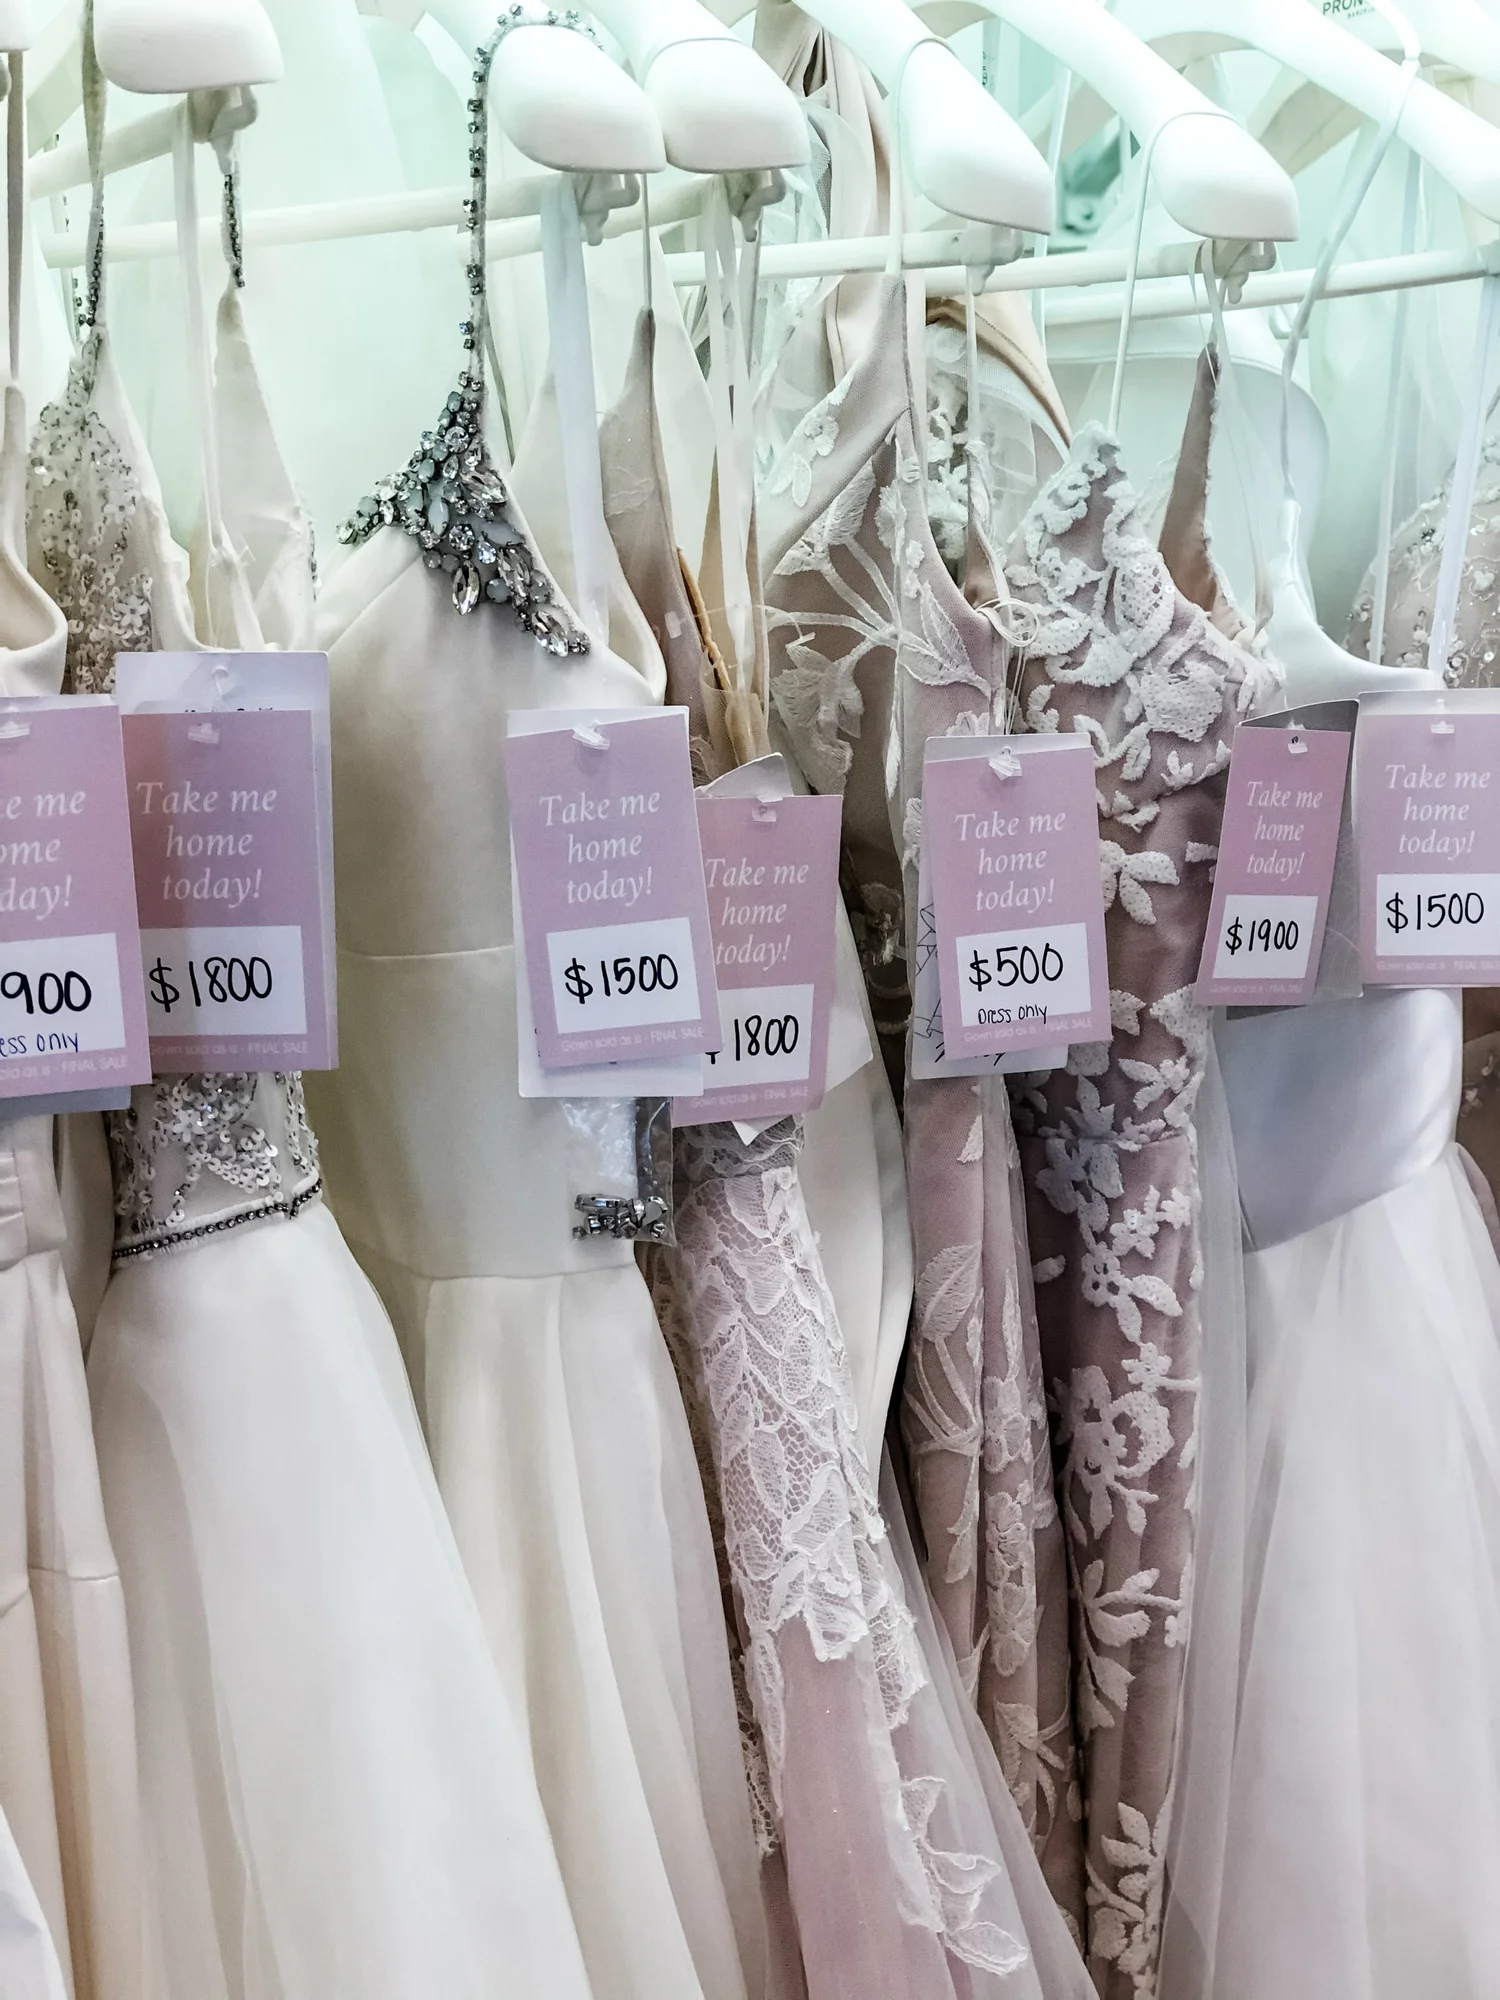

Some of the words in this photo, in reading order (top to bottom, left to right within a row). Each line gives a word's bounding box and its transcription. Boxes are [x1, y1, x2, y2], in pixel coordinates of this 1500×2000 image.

[1323, 0, 1368, 15] PRON
[1385, 764, 1446, 789] Take
[1455, 772, 1491, 788] me
[35, 791, 86, 817] me
[137, 780, 219, 815] Take
[231, 789, 278, 812] me
[538, 792, 610, 826] Take
[621, 792, 660, 816] me
[1247, 781, 1291, 807] Take
[1296, 790, 1323, 809] me
[1404, 796, 1470, 821] home
[166, 825, 253, 857] home
[955, 811, 1020, 841] Take
[1029, 812, 1066, 834] me
[1254, 815, 1304, 841] home
[568, 834, 643, 864] home
[1399, 828, 1475, 860] today!
[706, 857, 766, 888] Take
[773, 864, 809, 885] me
[978, 849, 1047, 875] home
[1247, 849, 1305, 882] today!
[163, 867, 262, 909] today!
[567, 865, 652, 907] today!
[976, 878, 1055, 913] today!
[722, 897, 787, 926] home
[1386, 892, 1484, 933] $1500
[1225, 916, 1299, 955] $1900
[716, 934, 791, 971] today!
[969, 942, 1063, 992] $500
[0, 971, 92, 1015] 900
[149, 957, 272, 1013] $1800
[564, 954, 679, 1004] $1500
[978, 1007, 1012, 1024] Dress
[1018, 1004, 1048, 1024] only
[1072, 1017, 1093, 1029] SALE
[36, 1032, 79, 1053] only
[248, 1041, 280, 1053] FINAL
[283, 1040, 308, 1053] SALE
[650, 1029, 679, 1043] FINAL
[680, 1027, 704, 1039] SALE
[705, 1015, 799, 1064] 1800
[61, 1060, 97, 1073] FINAL
[100, 1055, 129, 1069] SALE
[764, 1088, 786, 1100] FINAL
[789, 1086, 809, 1097] SALE
